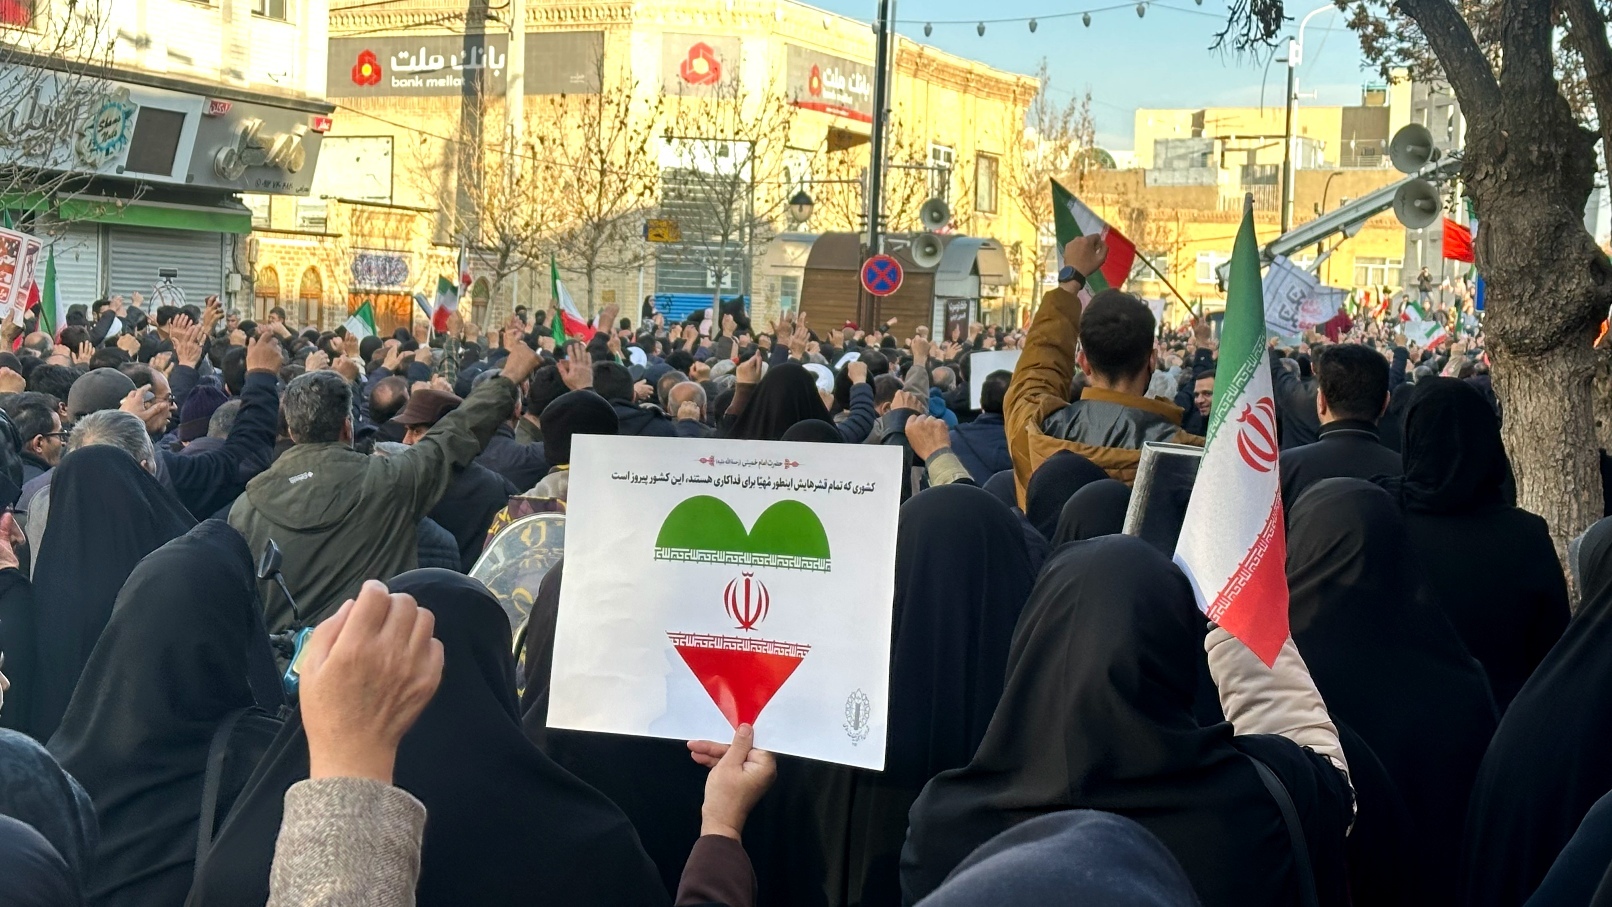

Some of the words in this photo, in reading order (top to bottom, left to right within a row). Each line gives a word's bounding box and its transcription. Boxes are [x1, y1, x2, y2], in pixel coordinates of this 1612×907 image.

[391, 46, 445, 72] ملت
[391, 75, 423, 87] bank
[741, 459, 758, 467] خمینی
[758, 459, 768, 469] امام
[767, 459, 783, 468] حضرت
[611, 470, 631, 480] است
[630, 472, 649, 485] پیروز
[649, 472, 671, 484] کشور
[671, 473, 685, 485] این
[713, 473, 741, 487] فداکاری
[741, 476, 756, 489] برای
[771, 477, 793, 490] اینطور
[794, 478, 828, 492] قشرهایش
[828, 481, 843, 493] تمام
[843, 481, 852, 490] که
[852, 481, 876, 494] کشوری
